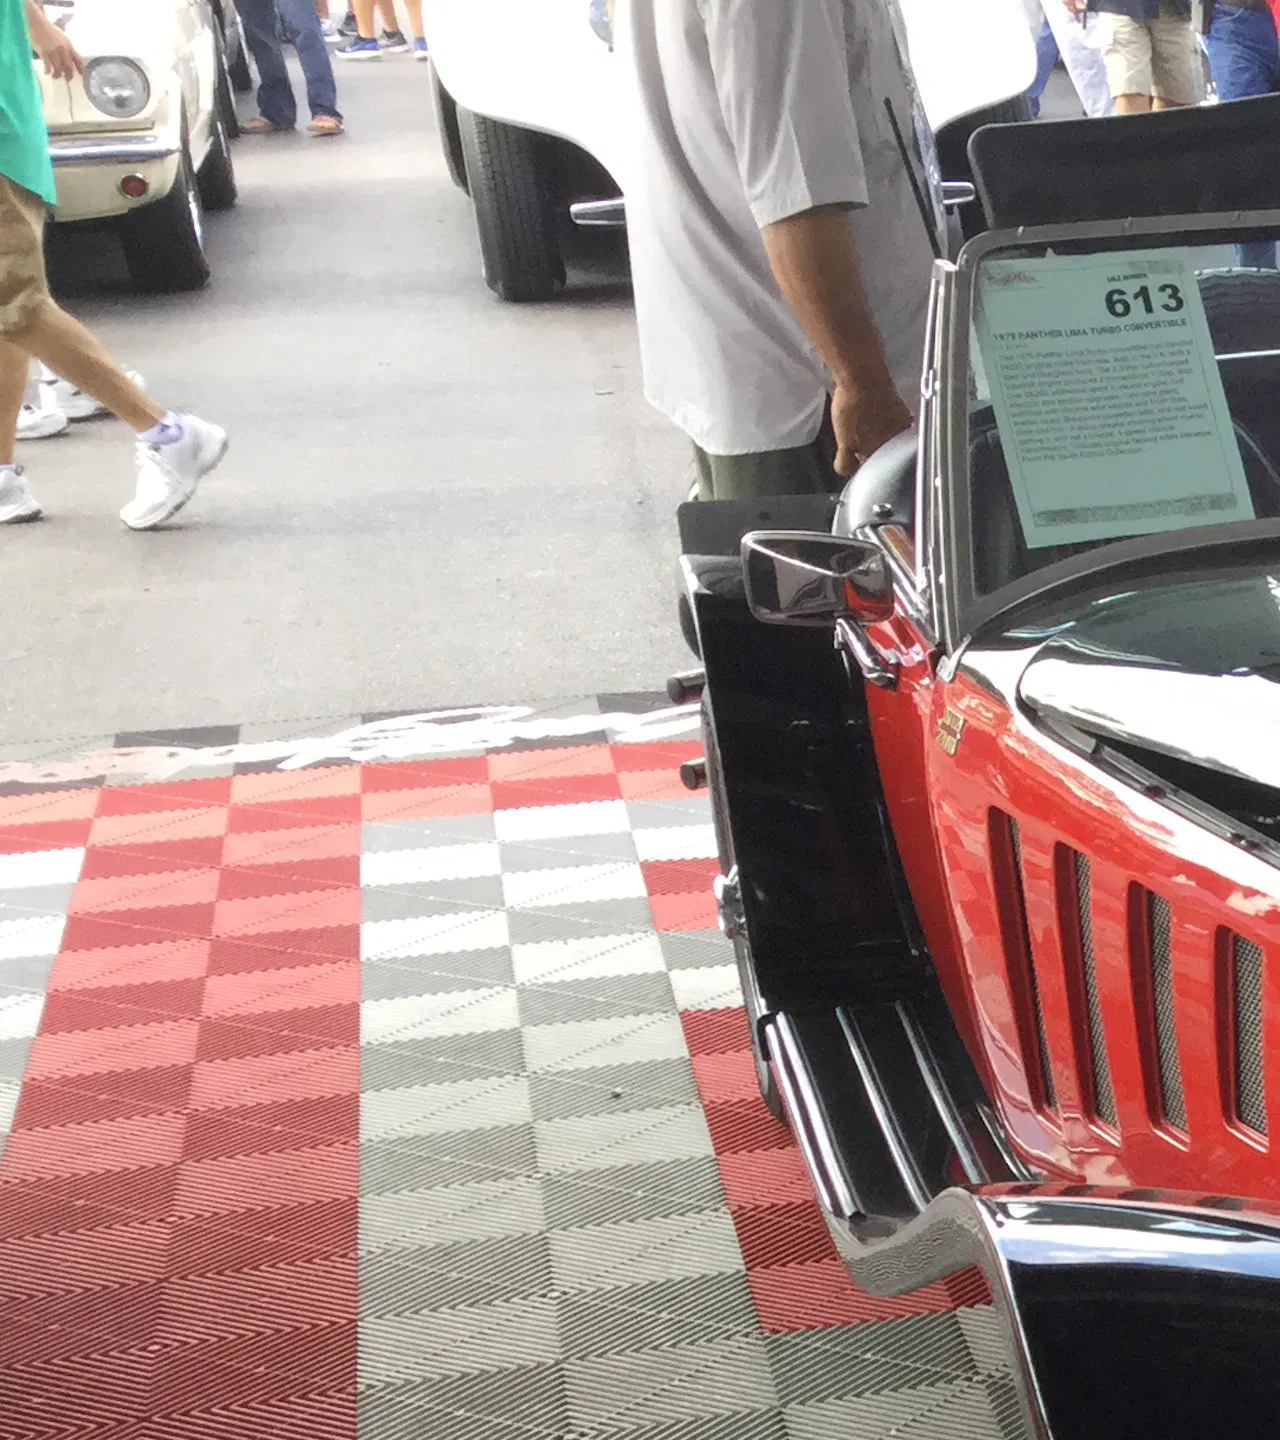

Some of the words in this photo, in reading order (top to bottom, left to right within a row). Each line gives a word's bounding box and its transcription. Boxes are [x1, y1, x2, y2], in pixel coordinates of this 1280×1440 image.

[1104, 283, 1184, 318] 613
[1018, 328, 1063, 341] PANTHER
[1065, 328, 1089, 338] LIMA
[1090, 325, 1122, 336] TURBO
[1123, 318, 1188, 333] CONVERTIBLE
